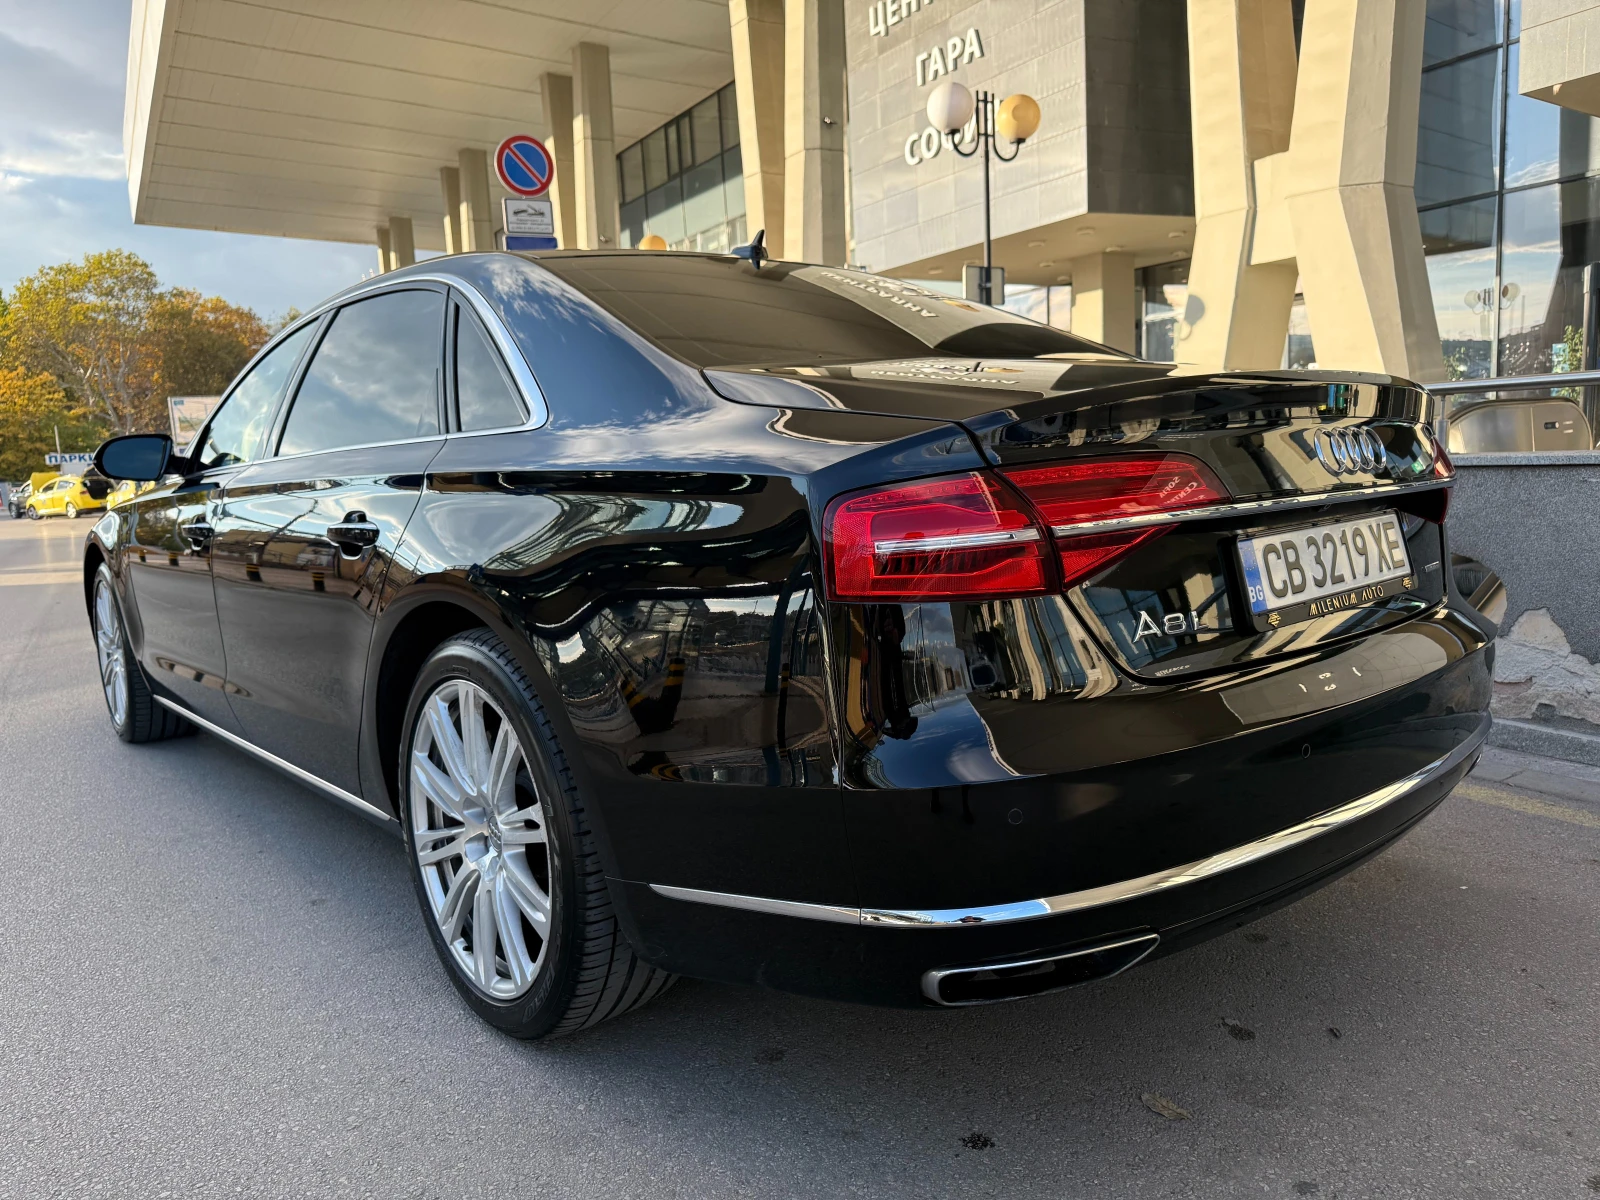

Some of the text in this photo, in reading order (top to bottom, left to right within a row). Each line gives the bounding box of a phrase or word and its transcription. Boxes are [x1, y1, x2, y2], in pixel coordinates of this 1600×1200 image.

[868, 0, 933, 37] ЦЕН
[915, 27, 984, 87] ГАРА
[1263, 521, 1406, 598] CB 3219 XE
[1248, 585, 1265, 603] BG
[1309, 585, 1384, 617] MILENIUM AUTO
[1132, 610, 1209, 643] A8L
